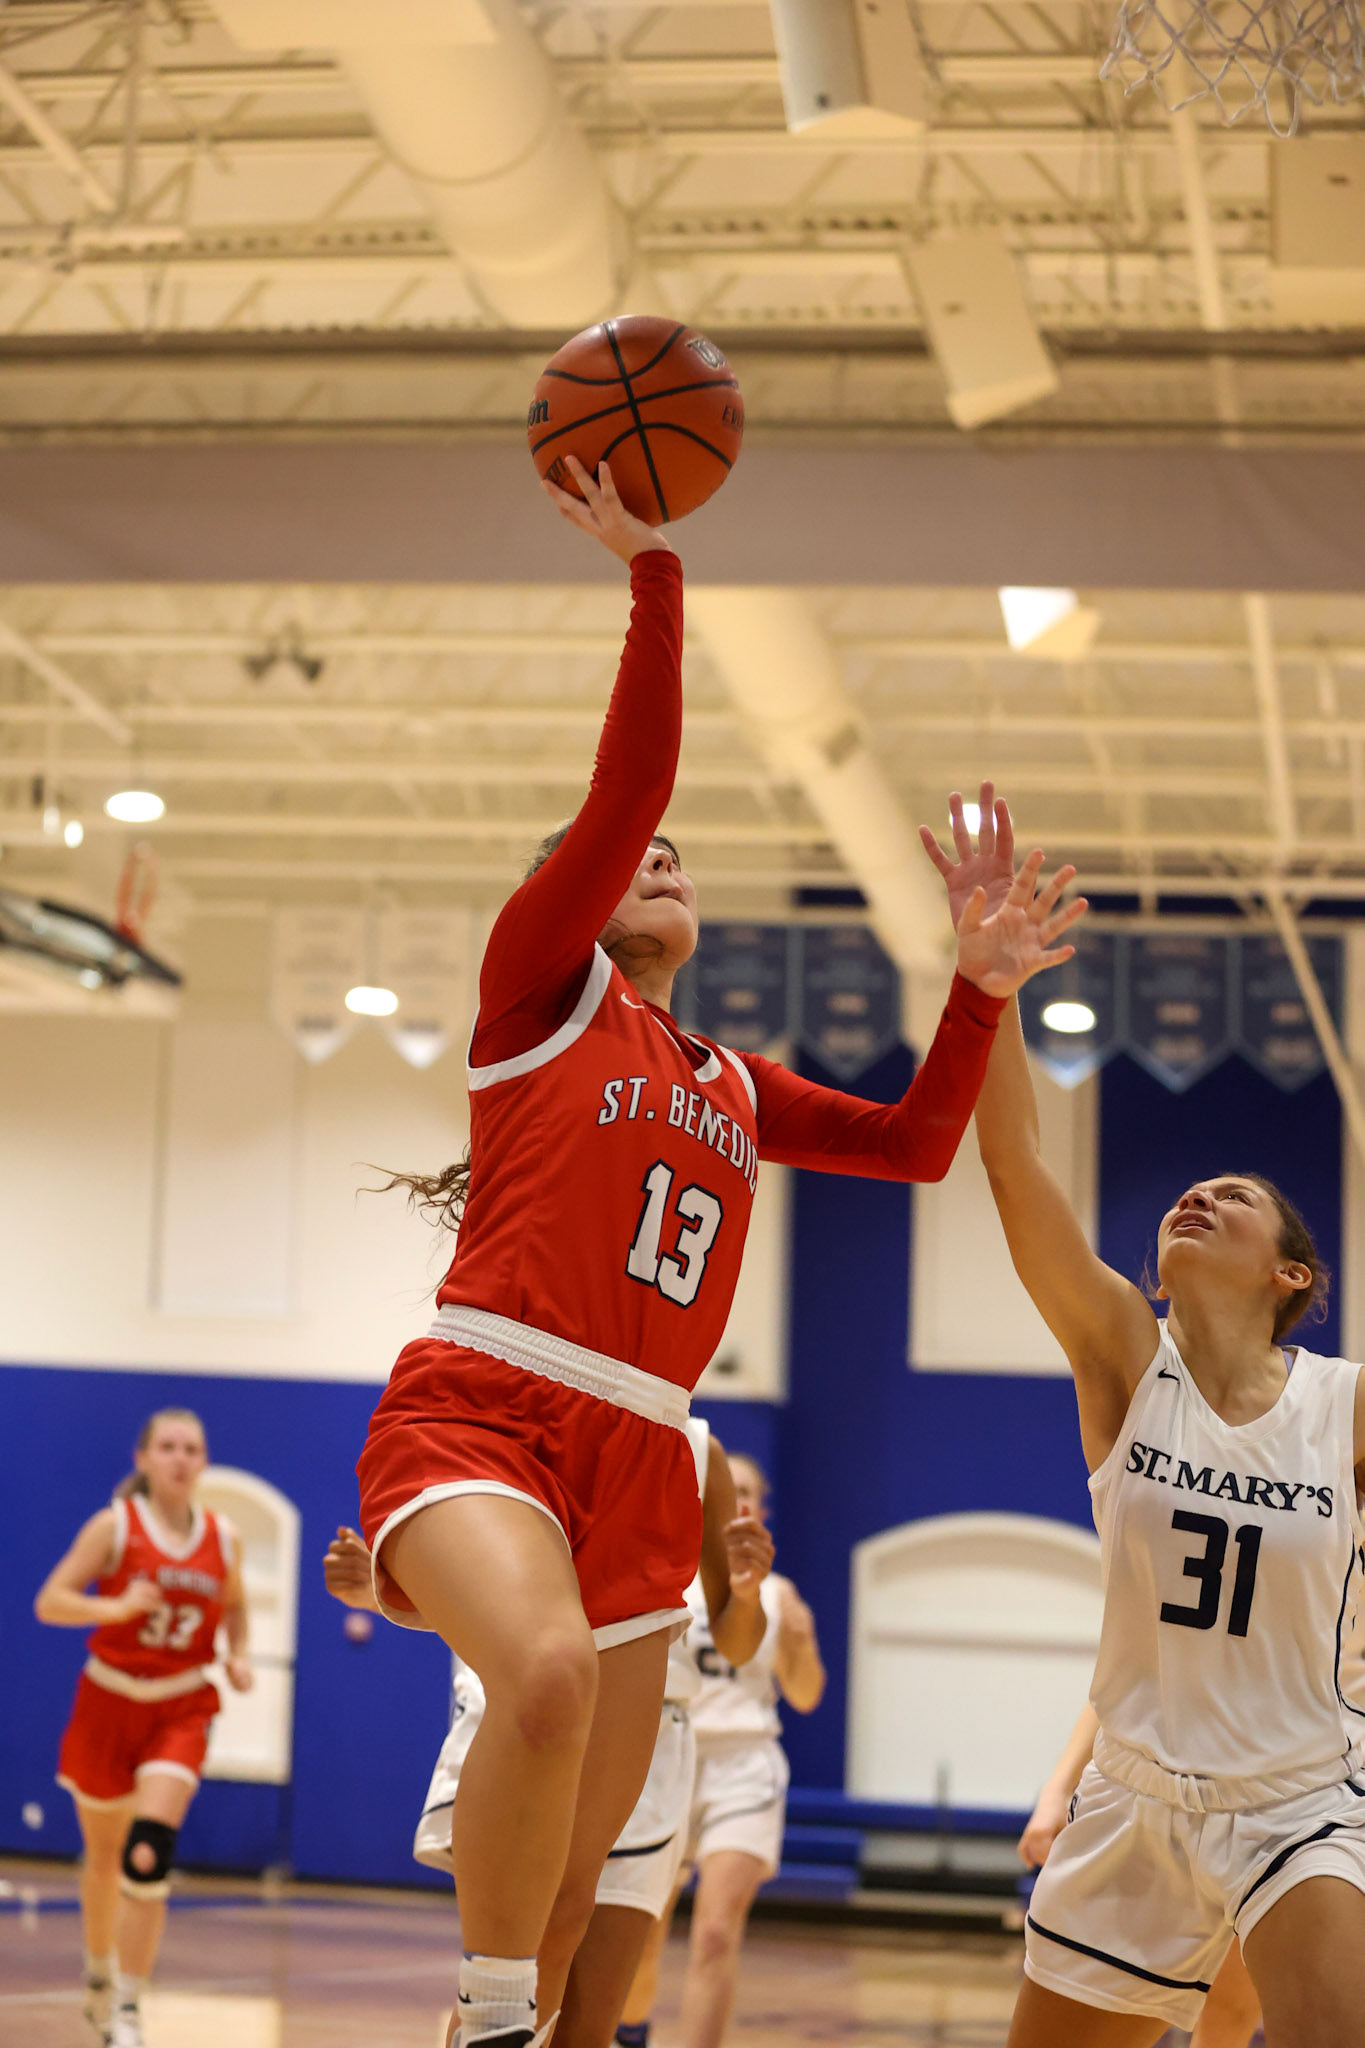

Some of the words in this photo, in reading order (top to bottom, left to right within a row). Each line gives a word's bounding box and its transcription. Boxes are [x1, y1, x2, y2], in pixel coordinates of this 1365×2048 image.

[597, 1076, 655, 1126] ST.
[624, 1158, 724, 1310] 13
[1125, 1441, 1172, 1483] ST.
[1172, 1460, 1334, 1518] MARY'S
[1159, 1508, 1263, 1638] 31
